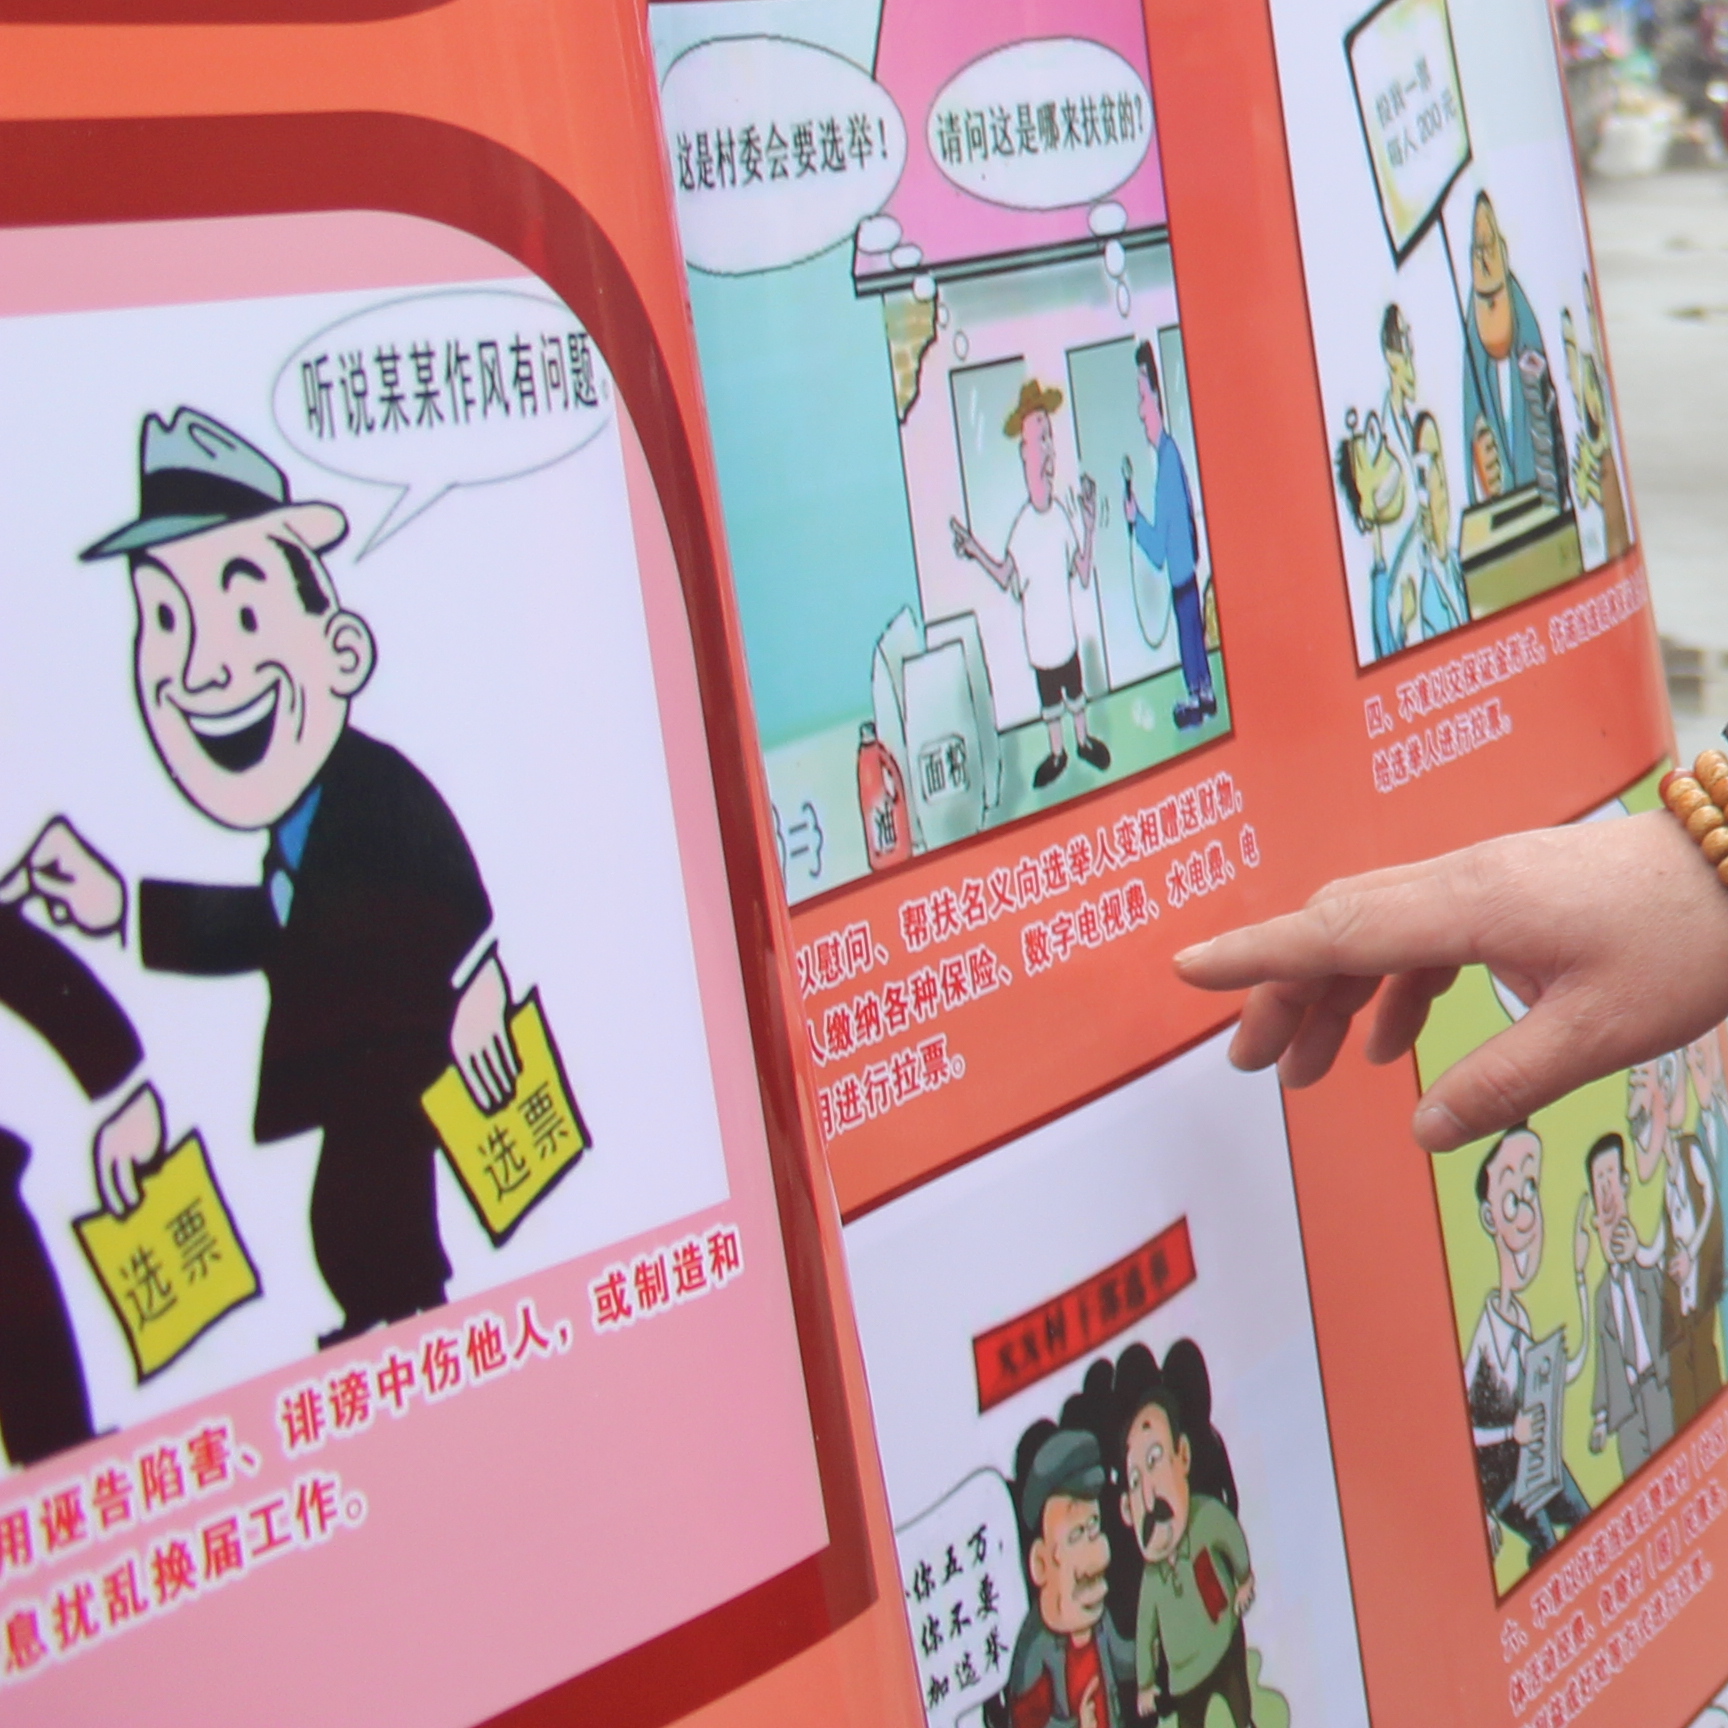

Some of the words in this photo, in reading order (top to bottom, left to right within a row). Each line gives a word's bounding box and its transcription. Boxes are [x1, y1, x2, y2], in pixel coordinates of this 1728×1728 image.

[477, 1080, 571, 1203] 选票
[117, 1197, 222, 1332] 选票
[6, 1478, 366, 1674] 息扰乱换届工作。
